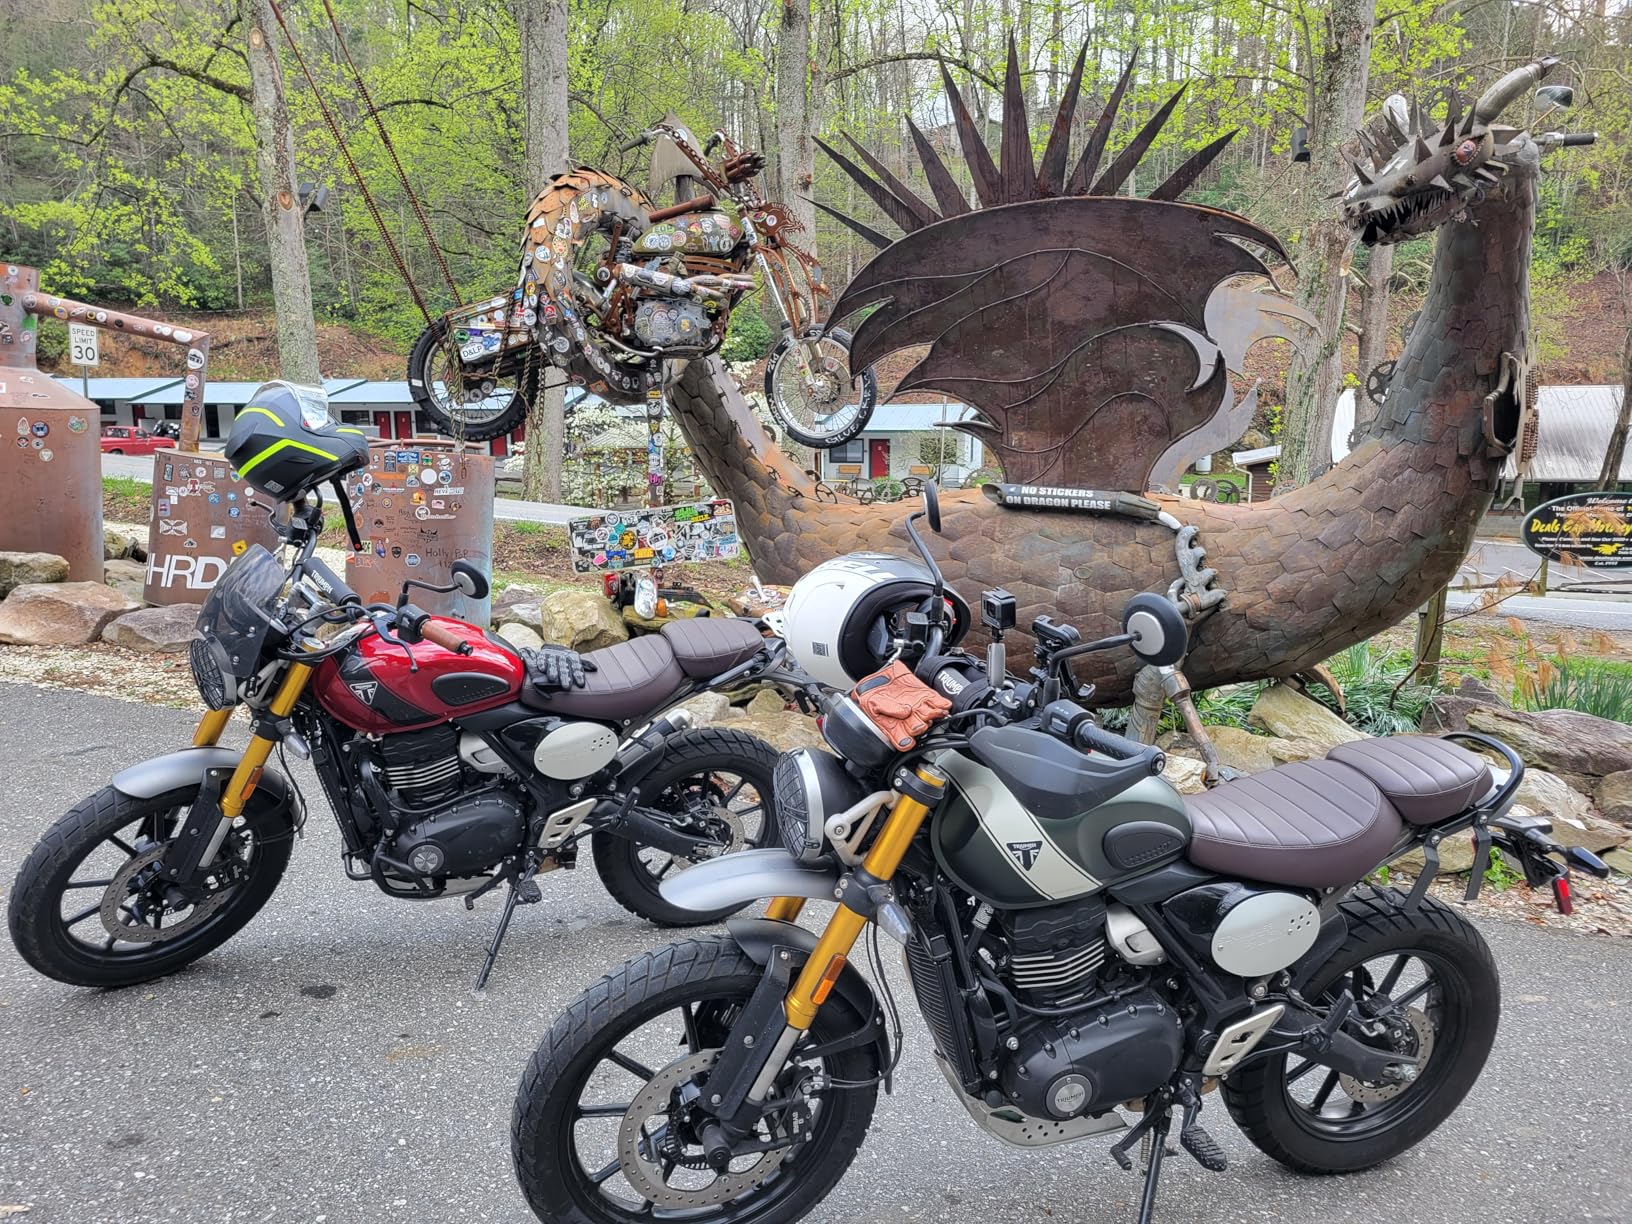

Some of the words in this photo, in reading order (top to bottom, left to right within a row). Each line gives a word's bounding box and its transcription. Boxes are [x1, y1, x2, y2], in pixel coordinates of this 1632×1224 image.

[72, 328, 95, 337] SPEED
[74, 337, 93, 345] LIMIT
[74, 345, 95, 361] 30
[1021, 486, 1034, 494] NO
[1038, 487, 1094, 498] STICKERS
[1005, 495, 1022, 504] ON
[1024, 496, 1069, 508] DRAGON
[1071, 499, 1112, 510] PLEASE
[1530, 518, 1561, 533] Deals
[311, 569, 334, 594] TRIUMPH
[938, 670, 963, 695] TRIUMP
